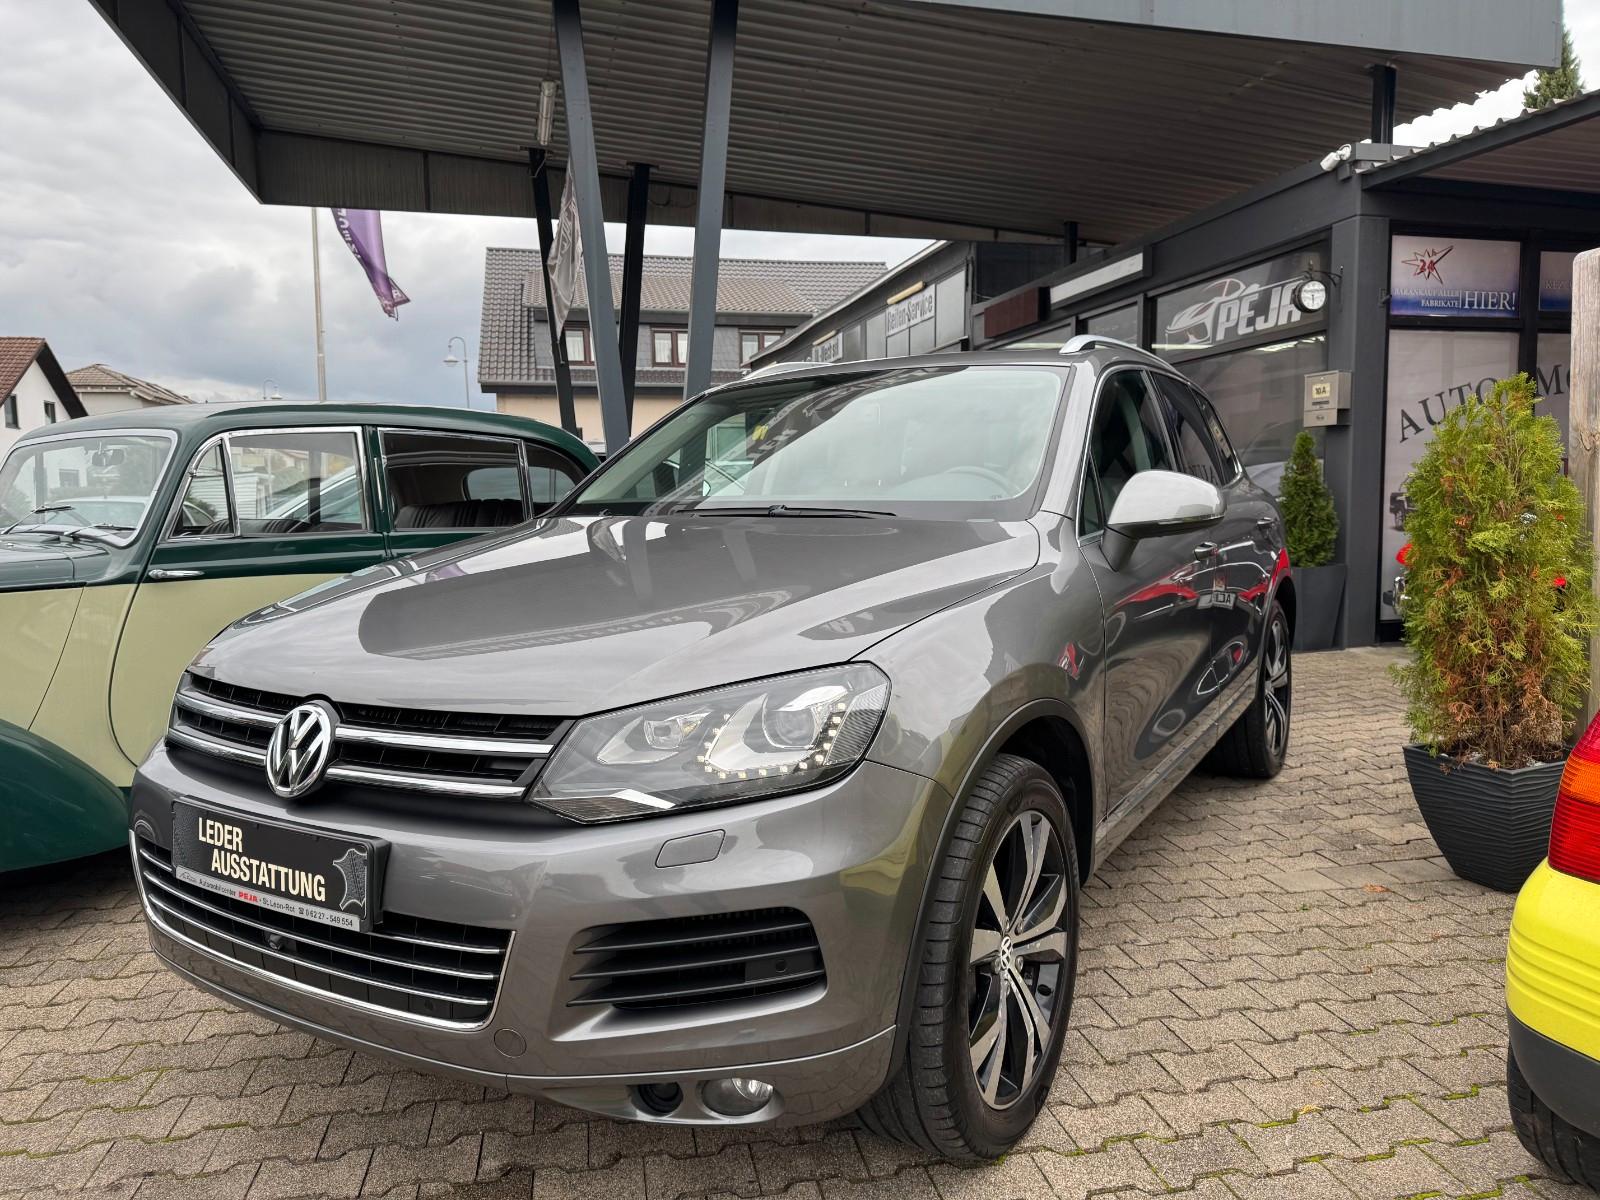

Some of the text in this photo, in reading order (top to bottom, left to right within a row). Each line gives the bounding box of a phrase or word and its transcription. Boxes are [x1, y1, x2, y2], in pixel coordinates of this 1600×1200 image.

[1421, 299, 1460, 308] FABRIKATE
[1463, 290, 1516, 310] HIER!
[198, 817, 243, 852] LEDER
[211, 848, 326, 902] AUSSTATTUNG
